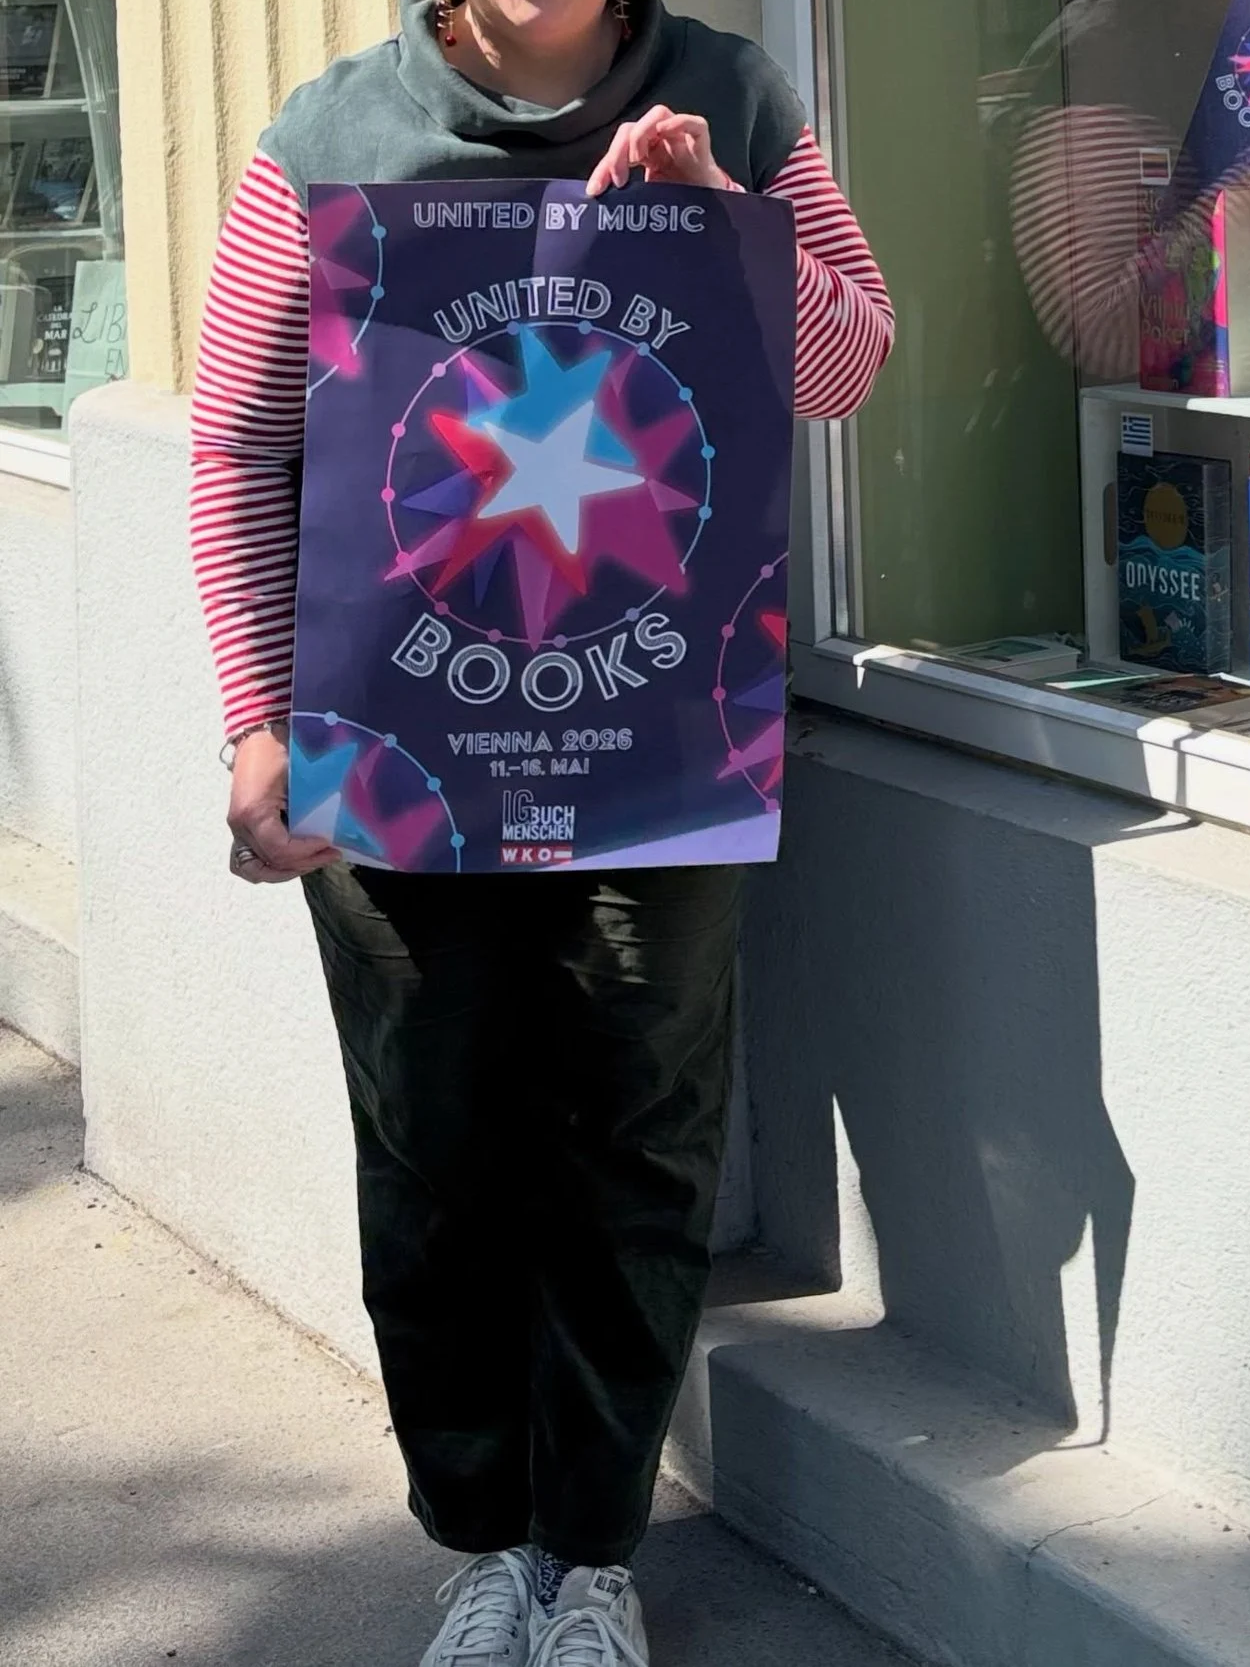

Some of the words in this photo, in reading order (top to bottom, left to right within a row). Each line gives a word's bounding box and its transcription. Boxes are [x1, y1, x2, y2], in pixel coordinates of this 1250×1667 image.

[413, 201, 535, 230] UNITED
[544, 200, 589, 232] BY
[597, 202, 706, 234] MUSIC
[72, 301, 126, 345] LIB
[433, 276, 613, 346] UNITED
[619, 295, 691, 352] BY
[44, 330, 67, 340] MAR
[1126, 561, 1201, 602] ODYSSEE
[390, 611, 689, 713] BOOKS
[447, 730, 553, 756] VIENNA
[561, 727, 633, 752] 2026
[550, 757, 590, 775] MAI
[502, 824, 574, 840] MENSCHEN
